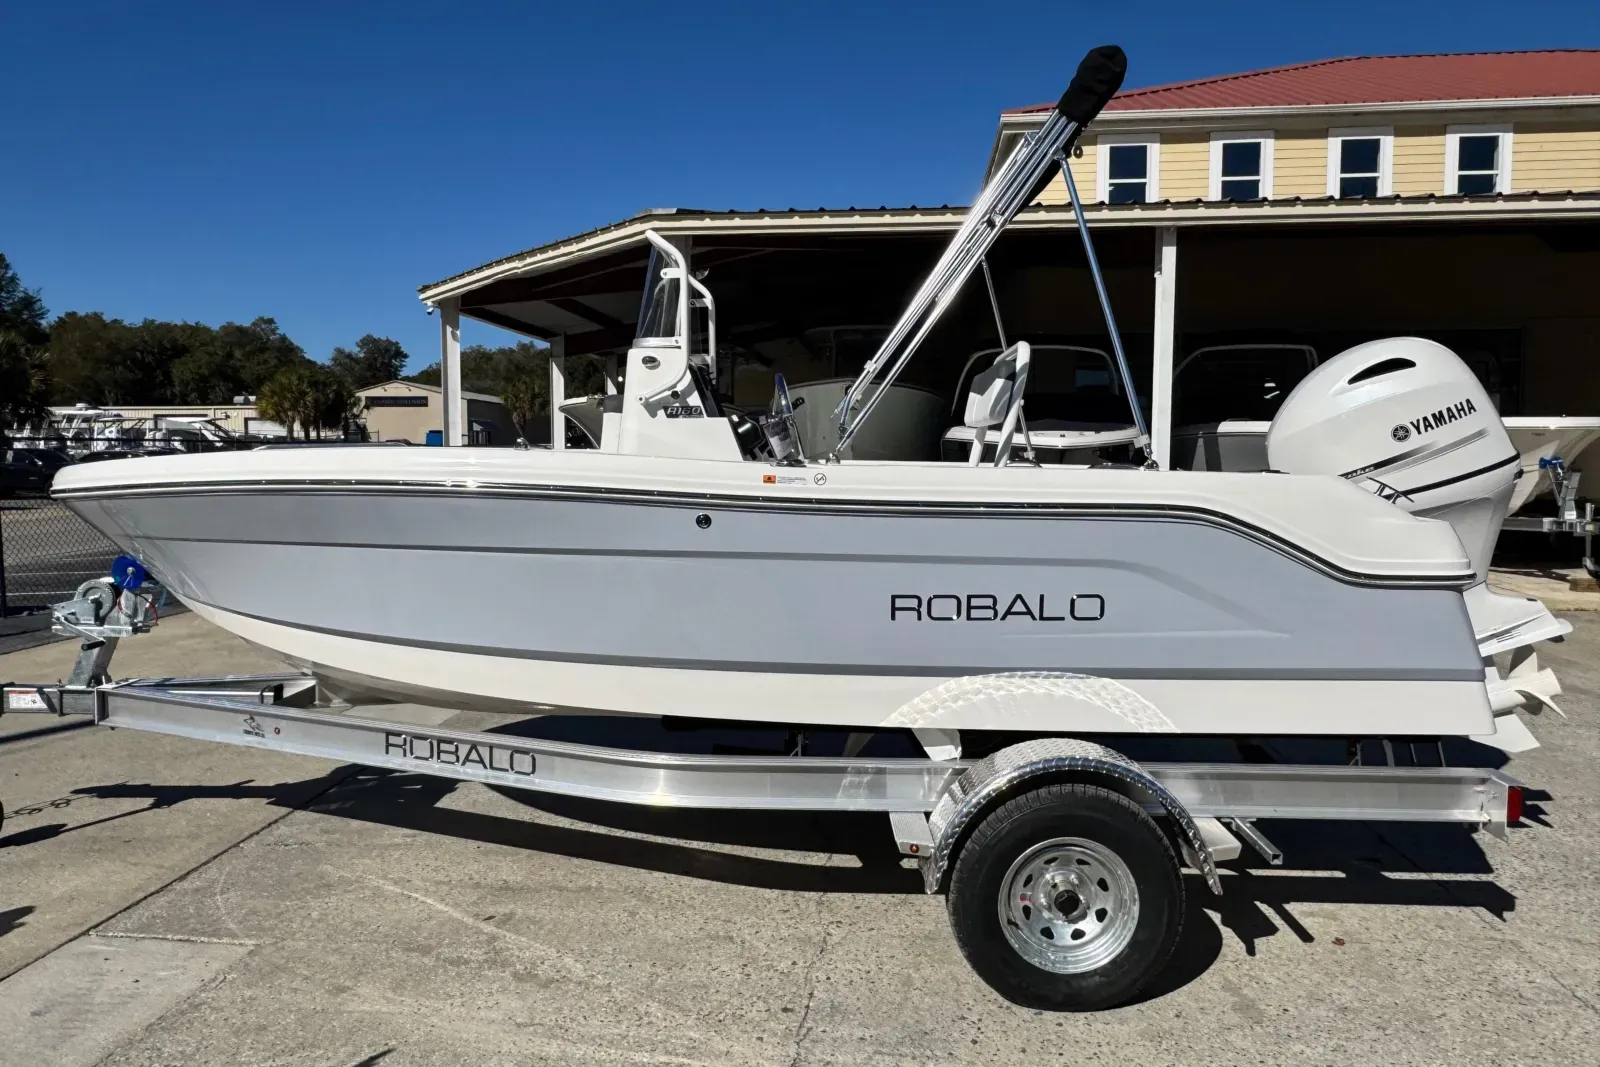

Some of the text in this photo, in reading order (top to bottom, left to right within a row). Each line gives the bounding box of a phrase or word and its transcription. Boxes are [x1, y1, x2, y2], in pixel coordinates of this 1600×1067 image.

[667, 407, 701, 415] R160
[1409, 398, 1477, 435] YAMAHA
[890, 593, 1105, 621] ROBALO
[385, 731, 537, 776] ROBALO
